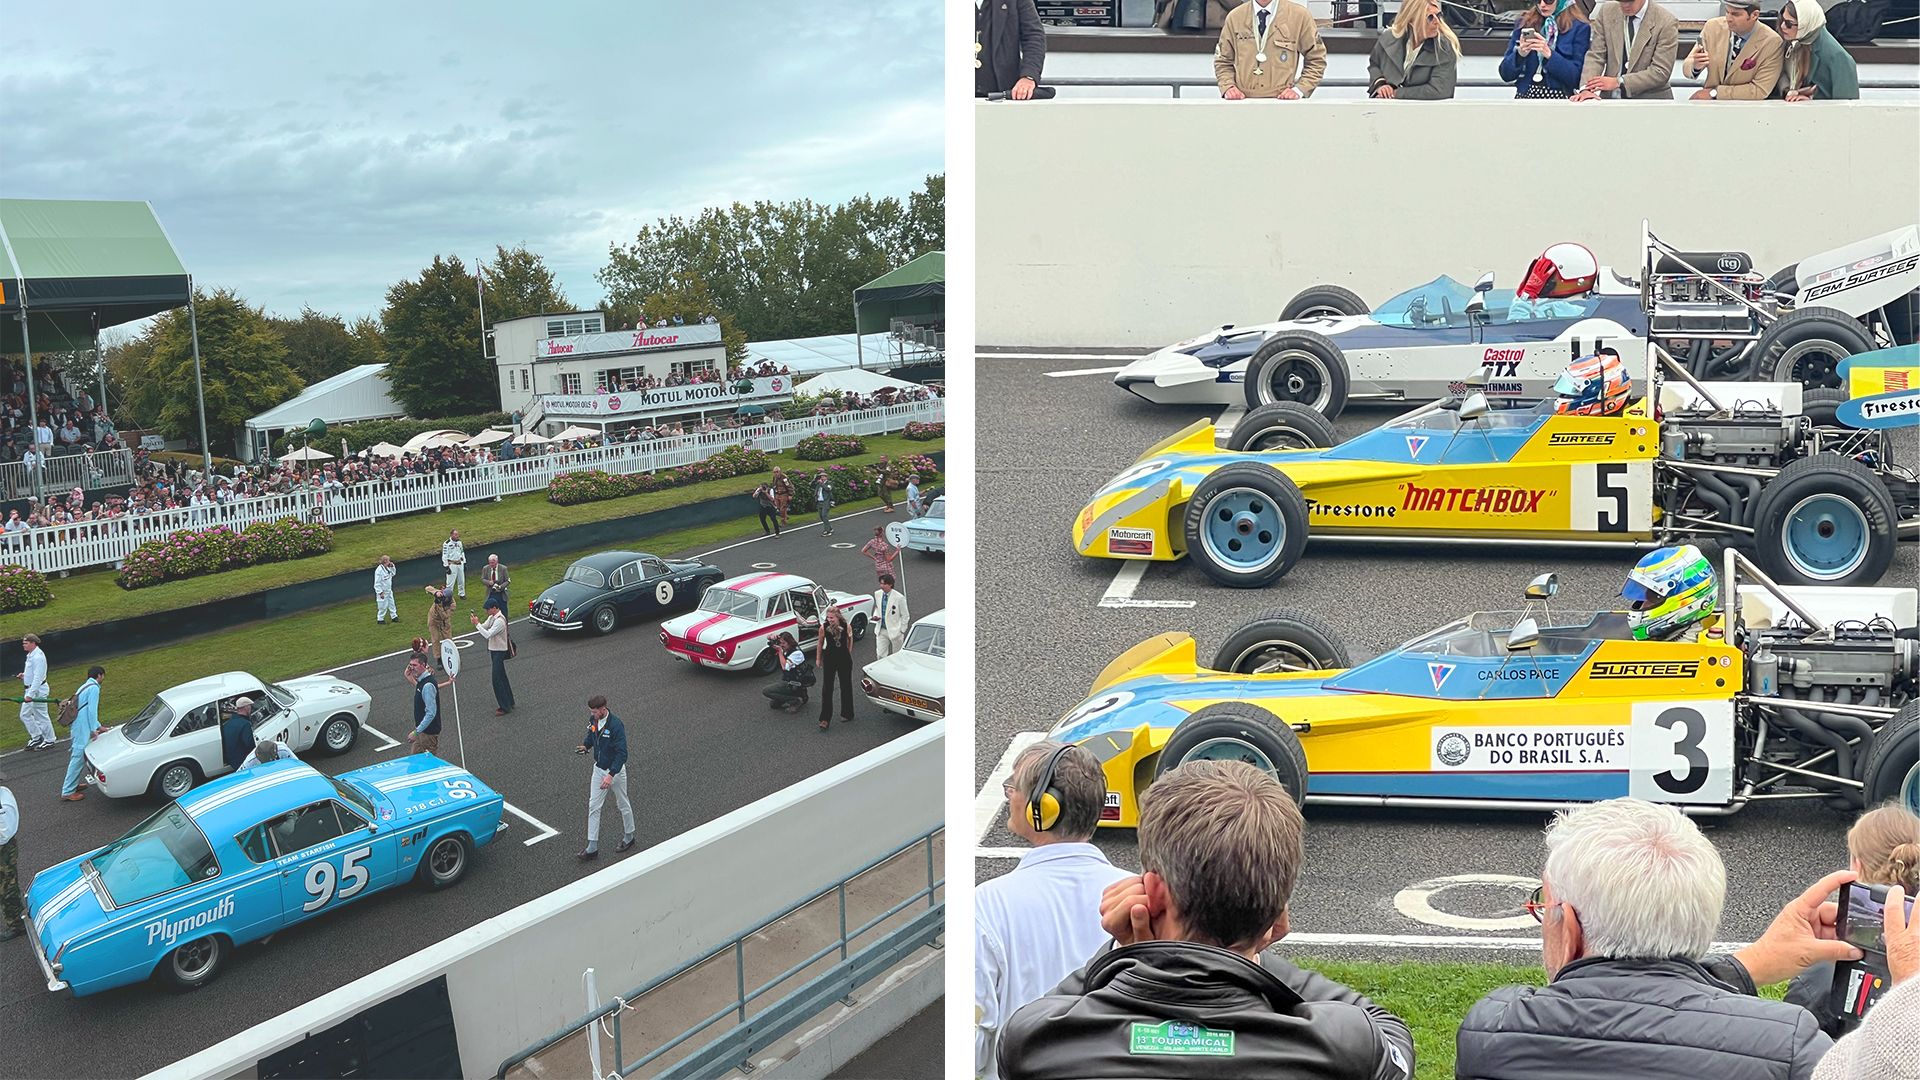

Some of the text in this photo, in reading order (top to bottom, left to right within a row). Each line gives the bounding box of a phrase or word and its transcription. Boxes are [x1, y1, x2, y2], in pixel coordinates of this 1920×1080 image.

[1804, 256, 1919, 303] TEAM SURTEES
[548, 341, 573, 354] Autocar
[632, 331, 679, 348] Autocar
[1484, 348, 1525, 361] Castrol
[641, 391, 682, 405] MOTUL
[685, 386, 727, 400] MOTOR
[1548, 432, 1617, 446] SURTEES
[1597, 463, 1628, 533] 5
[1305, 499, 1396, 517] Firestone
[895, 534, 900, 543] 5
[1111, 530, 1152, 540] Motorcraft
[661, 585, 668, 600] 5
[447, 656, 453, 670] 6
[1589, 660, 1699, 680] SURTEES
[1477, 669, 1560, 681] CARLOS PACE
[1474, 728, 1625, 748] BANCO PORTUGUÊS
[1490, 750, 1513, 764] DO
[1519, 749, 1574, 764] BRASIL
[1652, 706, 1710, 794] 3
[442, 780, 478, 799] 95
[404, 801, 427, 814] 318
[277, 842, 336, 866] TEAM STARFISH
[302, 846, 373, 913] 95
[144, 894, 235, 946] Plymouth
[1151, 1036, 1228, 1047] TOURAMICAL
